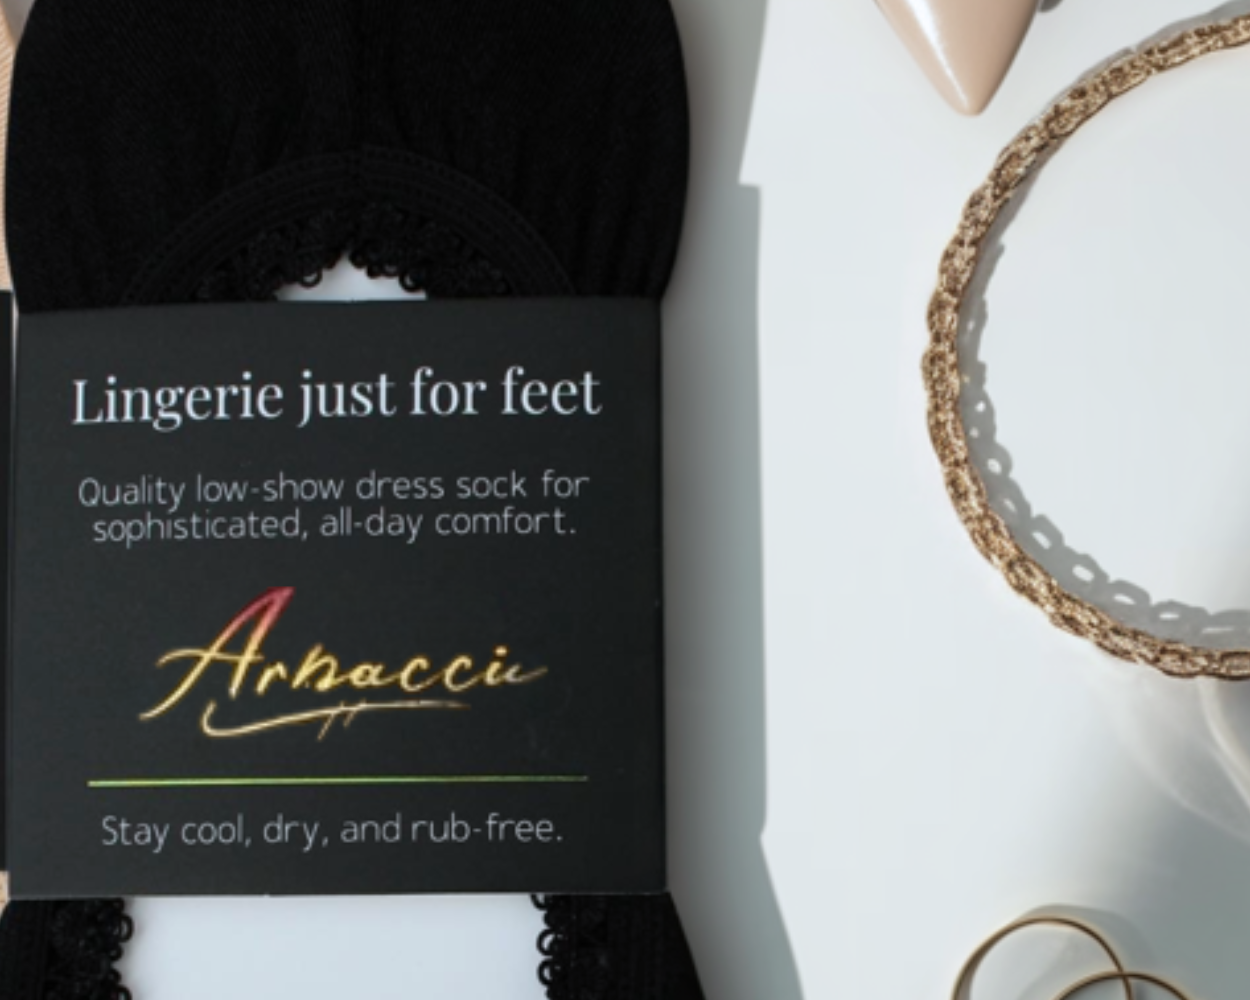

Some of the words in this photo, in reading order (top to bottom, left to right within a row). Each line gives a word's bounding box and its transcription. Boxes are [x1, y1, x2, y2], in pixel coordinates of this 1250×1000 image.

[72, 372, 284, 431] Lingerie
[297, 368, 398, 429] just
[409, 365, 488, 416] for
[500, 365, 603, 416] feet
[78, 475, 186, 510] Quality
[196, 471, 345, 503] low-show
[355, 469, 445, 500] dress
[456, 469, 527, 499] sock
[541, 468, 590, 499] for
[92, 512, 308, 547] sophisticated,
[319, 506, 424, 545] all-day
[434, 505, 576, 536] comfort.
[101, 815, 170, 854] Stay
[181, 814, 252, 847] cool,
[263, 813, 329, 853] dry,
[340, 812, 401, 843] and
[411, 811, 563, 843] rub-free.
